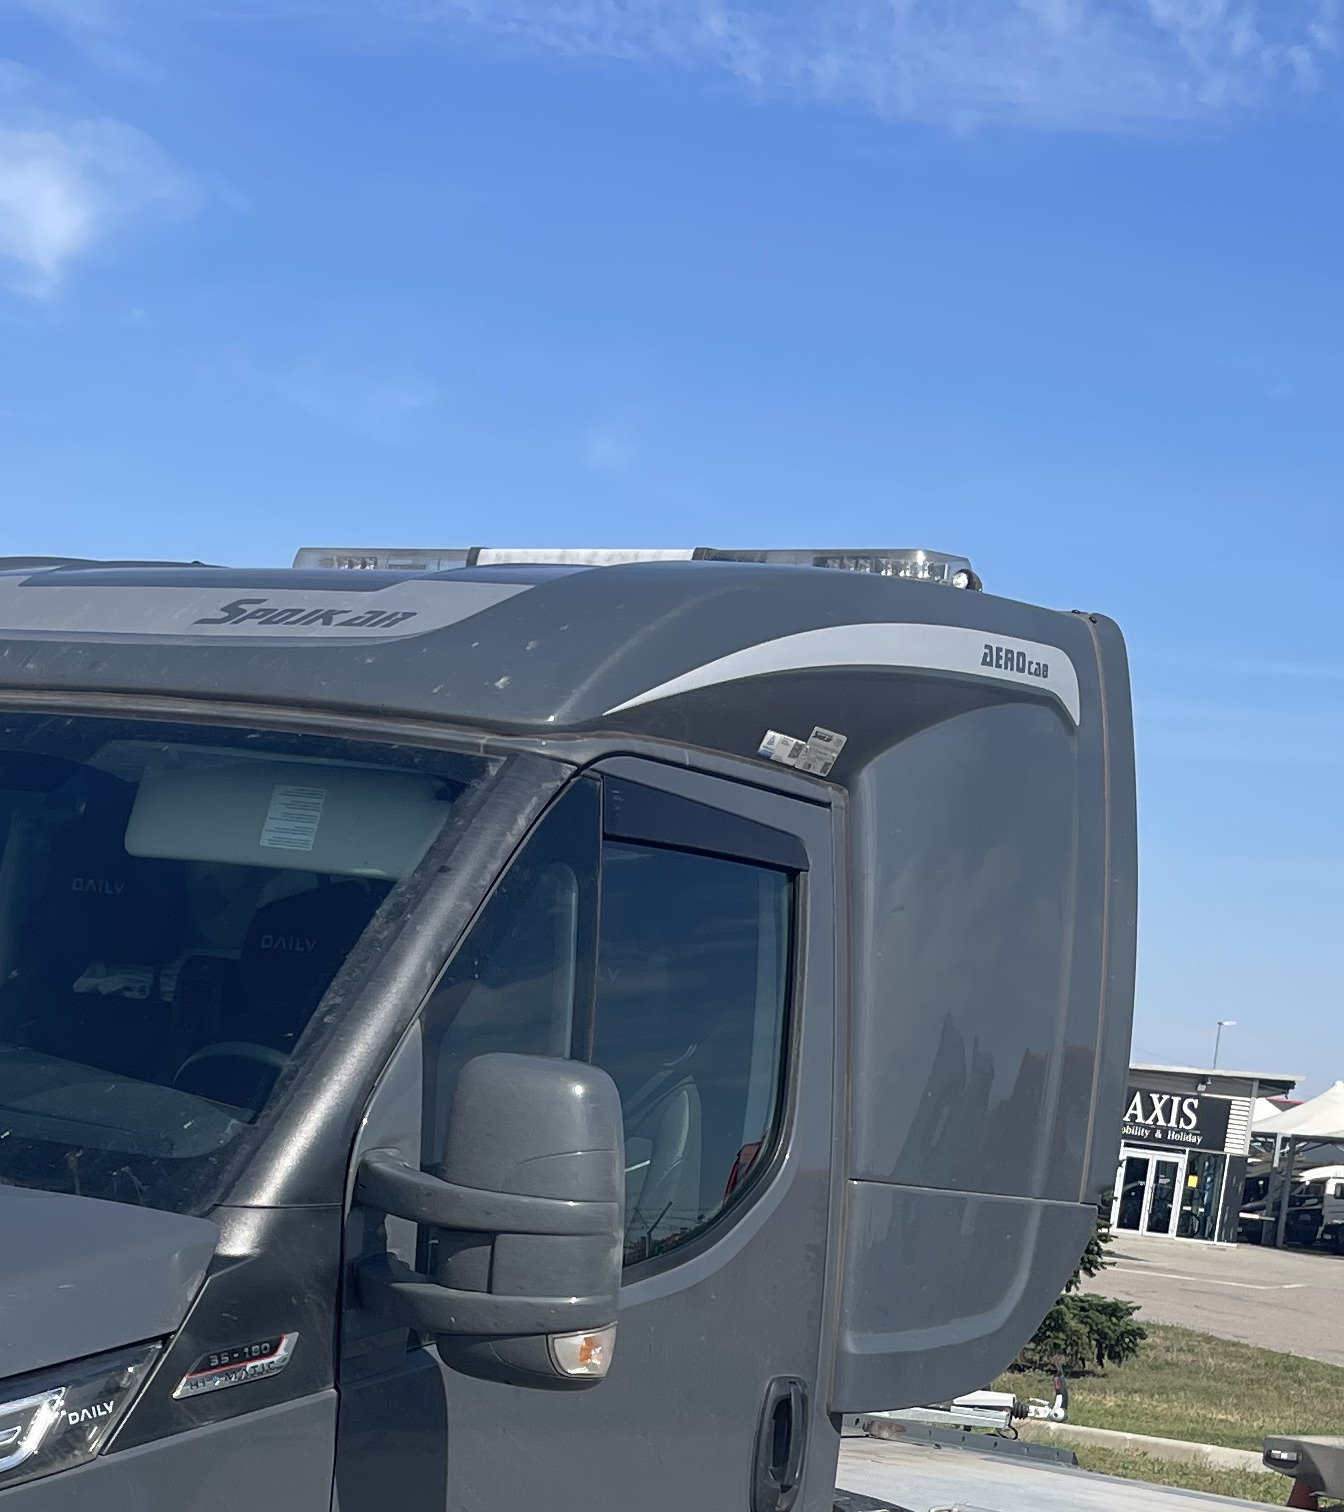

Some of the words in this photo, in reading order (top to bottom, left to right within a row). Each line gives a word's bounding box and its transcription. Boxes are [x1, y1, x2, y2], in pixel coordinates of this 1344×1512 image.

[1123, 1091, 1199, 1129] AXIS
[1155, 1129, 1162, 1138] &
[1168, 1129, 1203, 1145] Holiday
[68, 1400, 115, 1425] DAILY
